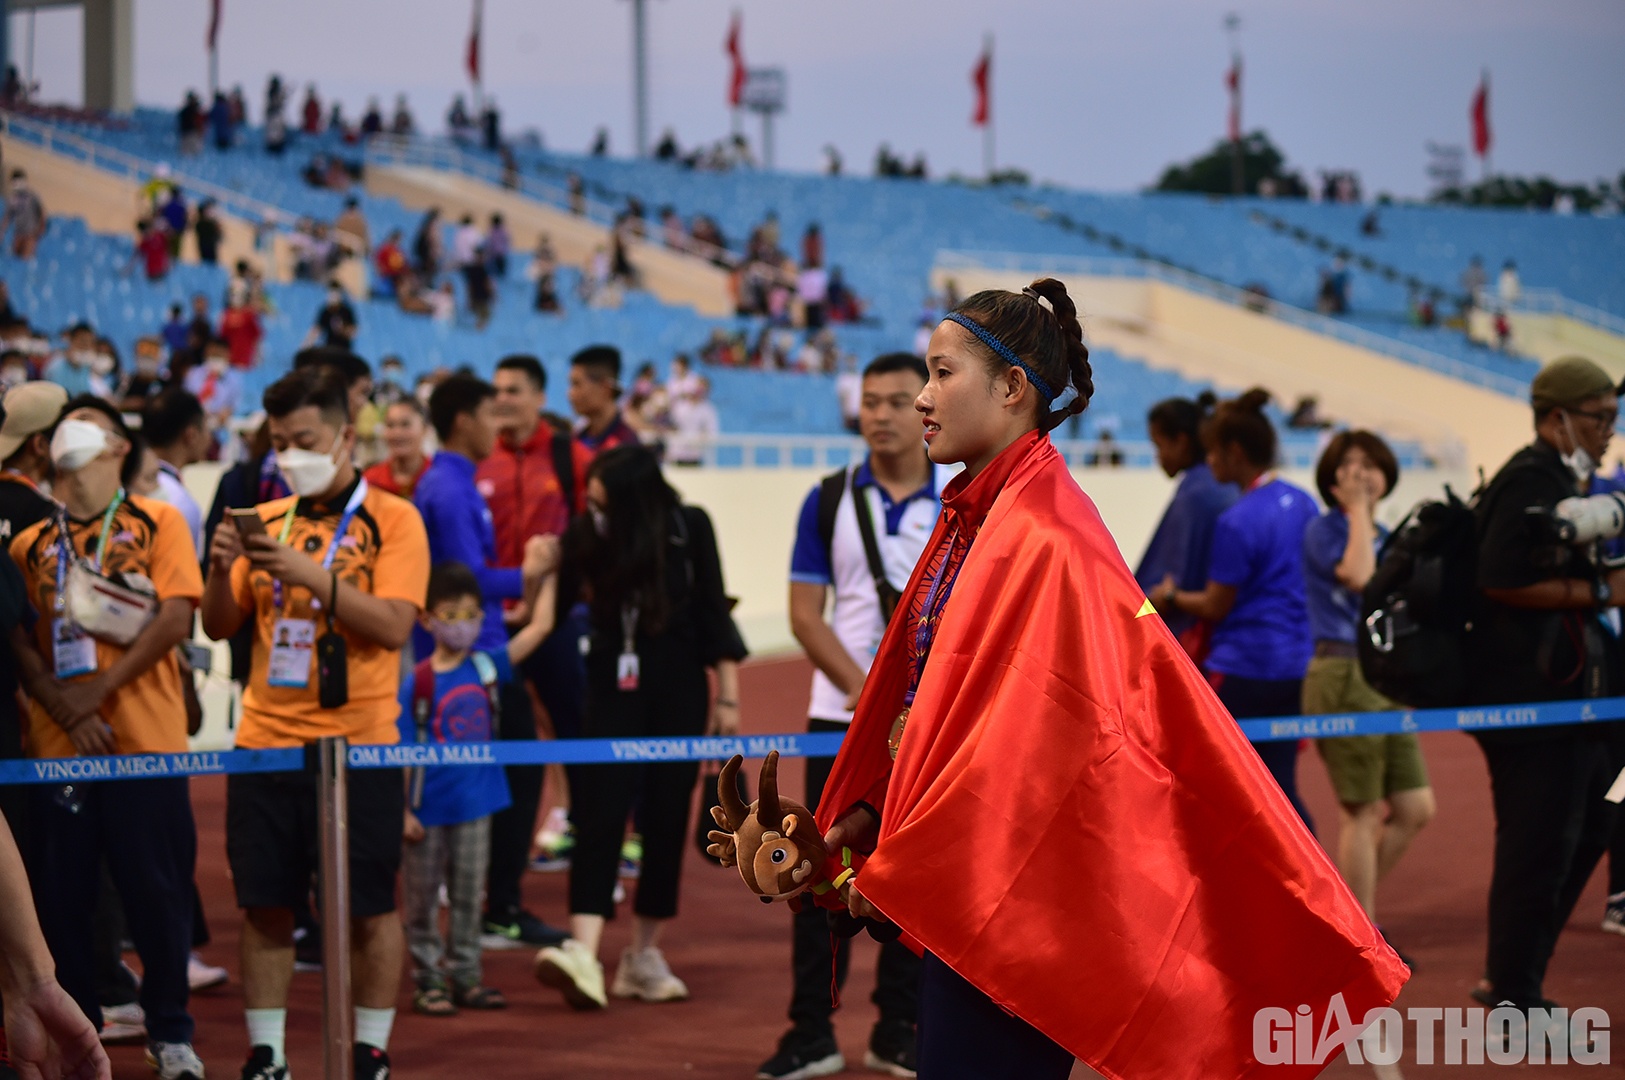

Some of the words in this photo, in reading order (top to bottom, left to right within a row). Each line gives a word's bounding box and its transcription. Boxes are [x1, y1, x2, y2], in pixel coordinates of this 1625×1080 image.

[1271, 719, 1319, 737] ROYAL
[1322, 717, 1356, 734] CITY
[1457, 709, 1503, 726] ROYAL
[1505, 707, 1538, 724] CITY
[384, 745, 439, 765] MEGA
[442, 744, 497, 764] MALL
[611, 739, 689, 760] VINCOM
[691, 738, 745, 758] MEGA
[748, 736, 801, 755] MALL
[34, 760, 111, 779] VINCOM
[115, 757, 169, 777] MEGA
[172, 753, 225, 773] MALL
